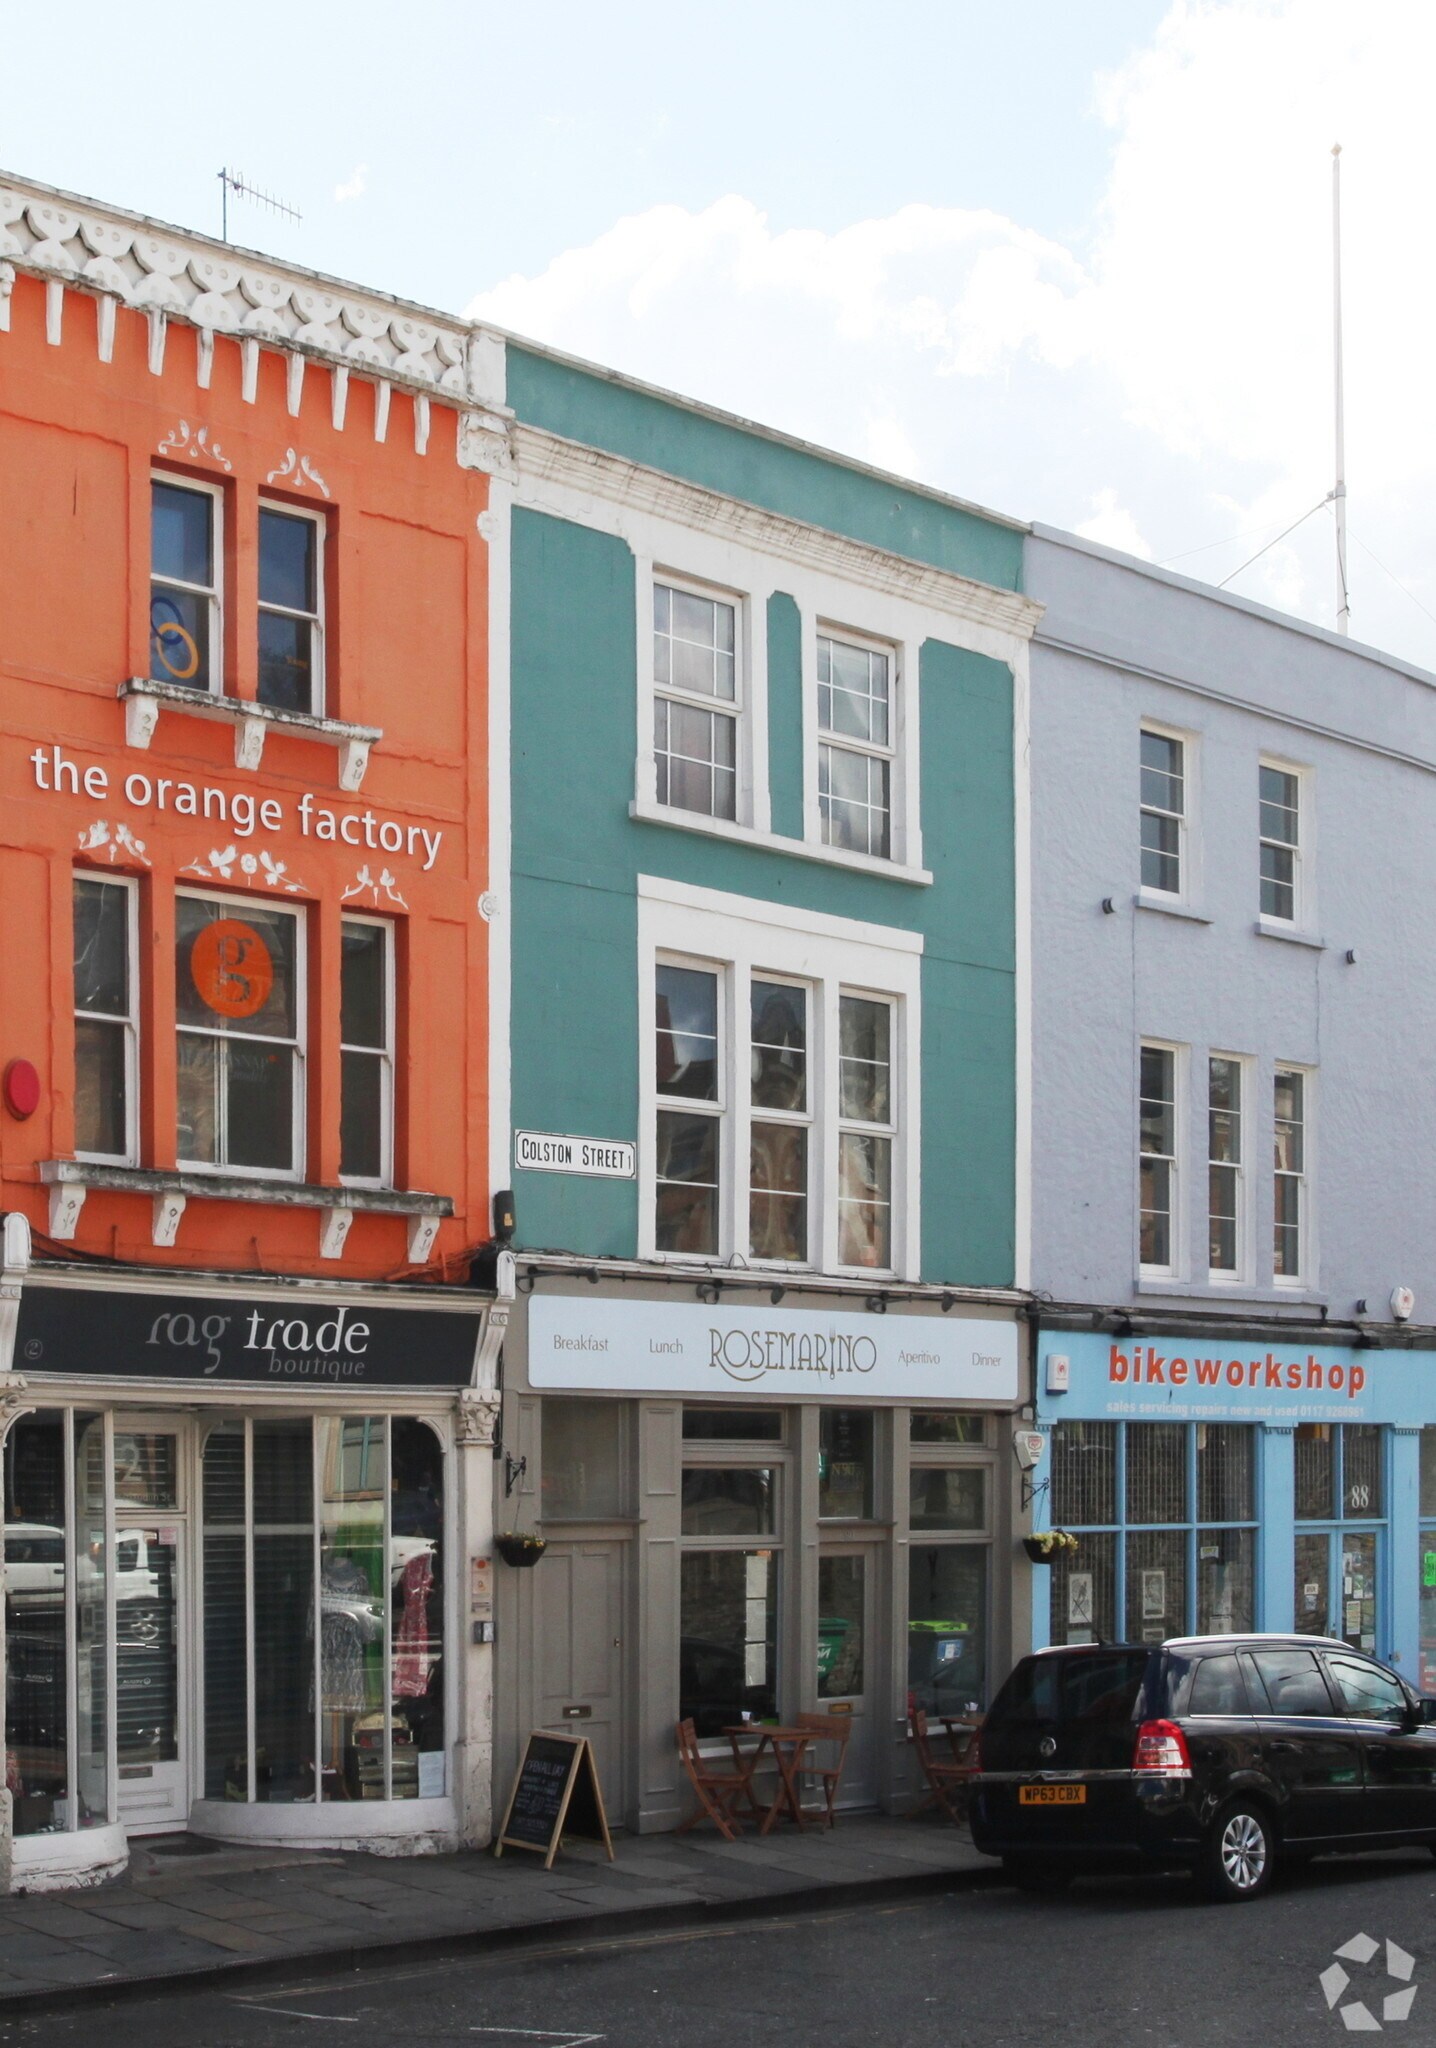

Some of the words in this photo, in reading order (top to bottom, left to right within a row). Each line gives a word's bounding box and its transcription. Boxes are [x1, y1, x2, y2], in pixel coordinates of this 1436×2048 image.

[30, 745, 109, 800] the
[125, 773, 283, 838] orange
[297, 793, 443, 870] factory
[521, 1138, 572, 1164] COLSTON
[582, 1144, 625, 1169] STREET
[145, 1312, 231, 1375] rag
[243, 1307, 370, 1354] trade
[553, 1334, 609, 1352] Breakfast
[649, 1338, 683, 1354] Lunch
[708, 1325, 878, 1382] ROSEMARINO
[268, 1350, 366, 1382] boutique
[898, 1349, 941, 1367] Aperitivo
[972, 1352, 1002, 1367] Dinner
[1106, 1402, 1136, 1414] sales
[1139, 1402, 1188, 1418] servicing
[1191, 1403, 1228, 1417] repairs
[1230, 1405, 1252, 1417] new
[1254, 1404, 1273, 1417] and
[1275, 1404, 1298, 1417] used
[1300, 1404, 1324, 1418] 0117
[1351, 1484, 1370, 1509] 88
[1024, 1787, 1056, 1801] WP63
[1058, 1786, 1080, 1801] CBX
